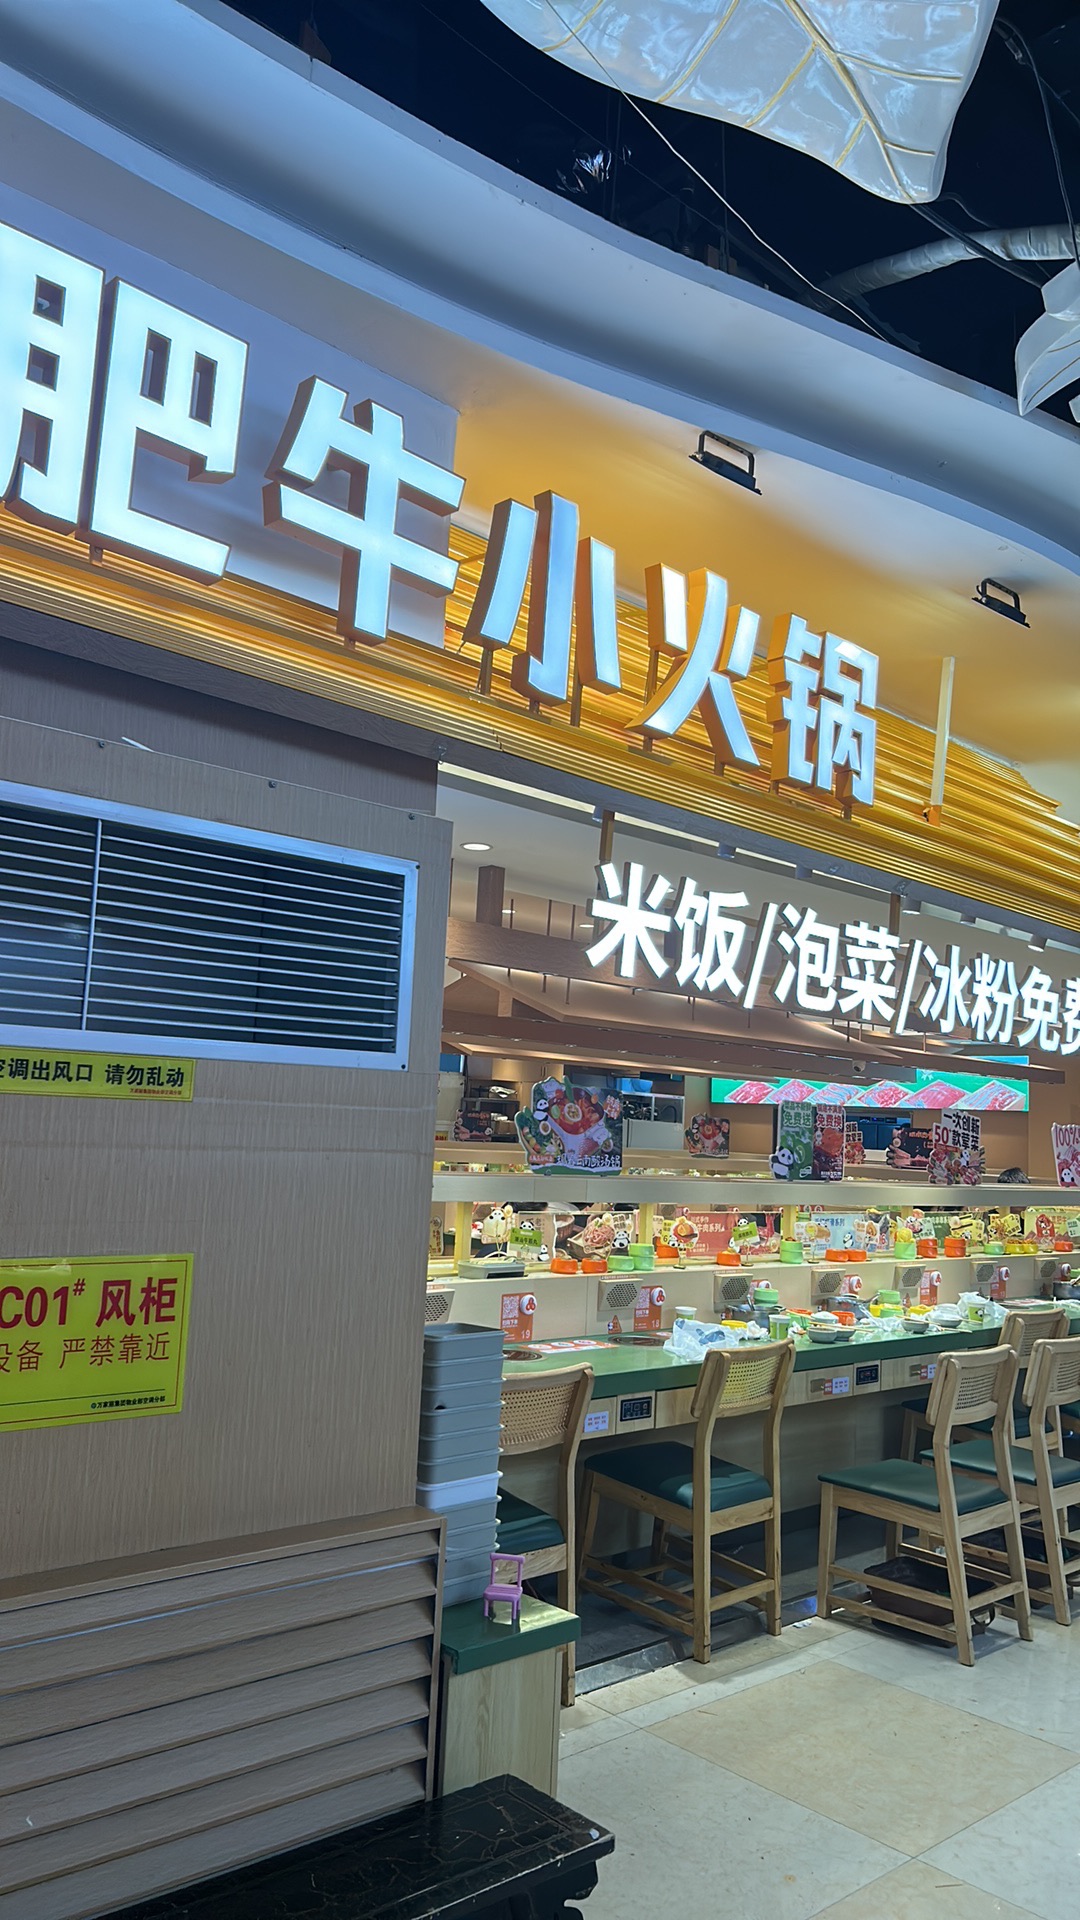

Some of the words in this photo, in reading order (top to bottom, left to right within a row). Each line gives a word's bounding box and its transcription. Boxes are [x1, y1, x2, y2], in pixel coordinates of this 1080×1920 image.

[0, 222, 880, 807] 肥牛小火锅
[104, 1064, 185, 1088] 请勿乱动
[783, 1111, 812, 1127] 免费送
[817, 1114, 843, 1128] 免费换
[943, 1111, 981, 1136] 一次创新
[1055, 1125, 1080, 1149] 100%
[0, 1278, 86, 1330] C01#
[95, 1276, 178, 1328] 风柜
[520, 1329, 531, 1340] 19
[651, 1319, 660, 1328] 18
[59, 1331, 171, 1370] 严禁靠近
